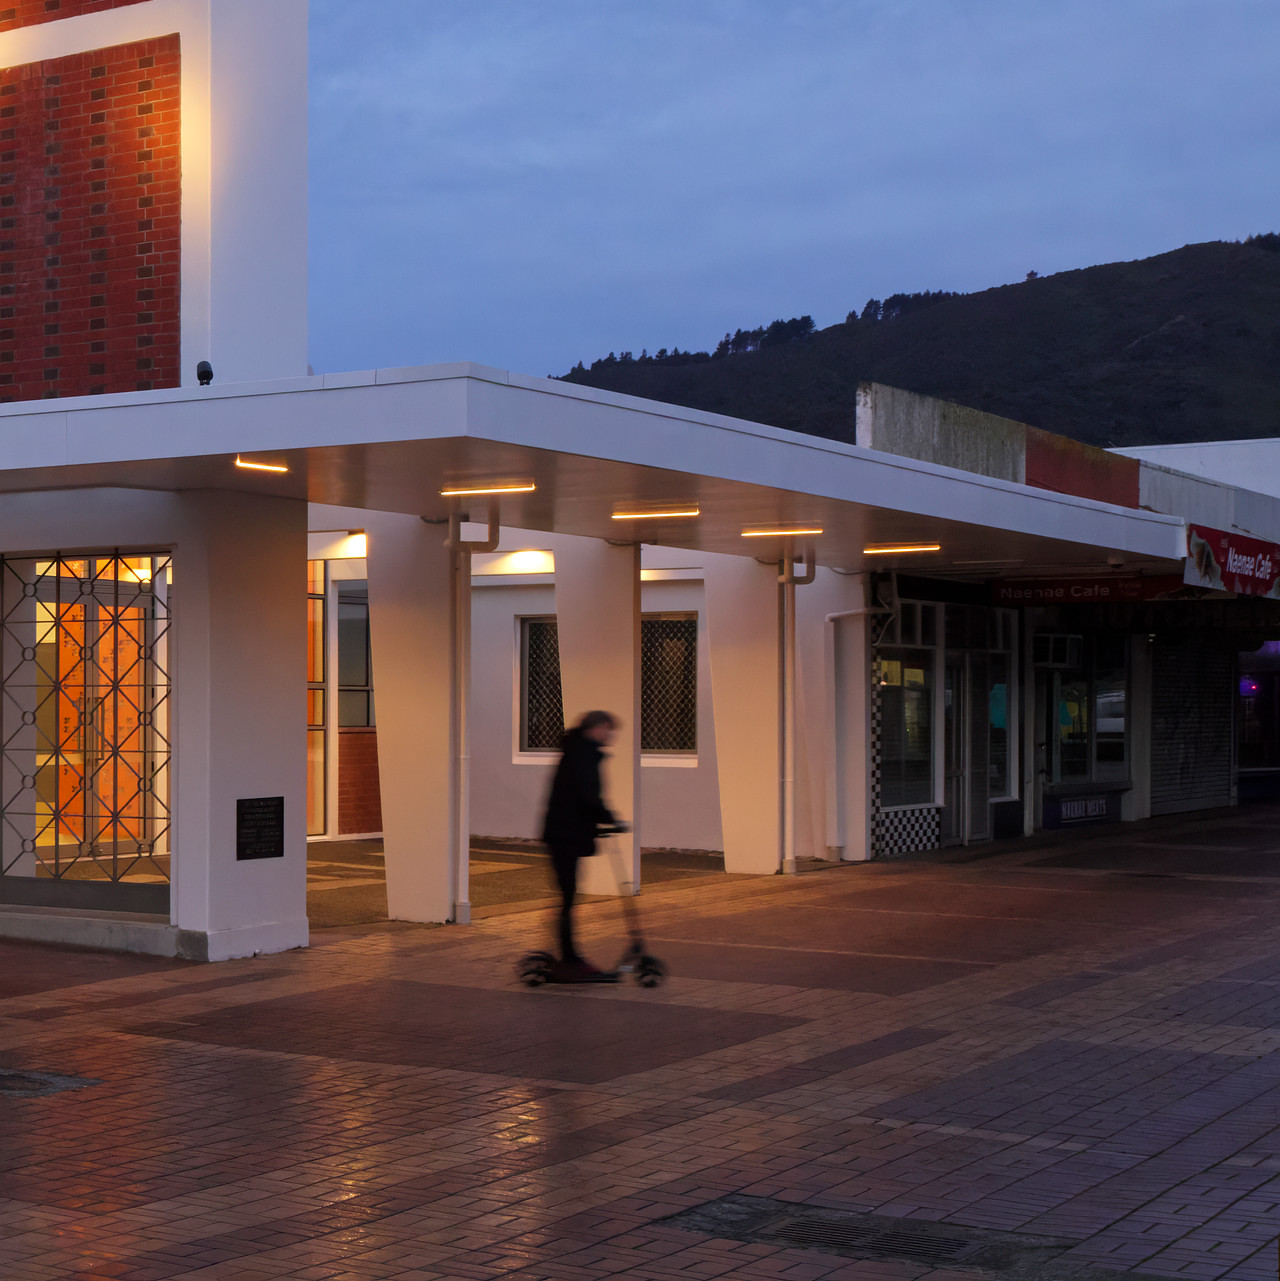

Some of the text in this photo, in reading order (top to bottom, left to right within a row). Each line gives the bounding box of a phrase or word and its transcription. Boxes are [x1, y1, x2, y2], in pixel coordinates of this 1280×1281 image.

[1226, 546, 1255, 576] Naenae
[1255, 552, 1272, 580] Cafe
[1000, 586, 1064, 600] Naenae
